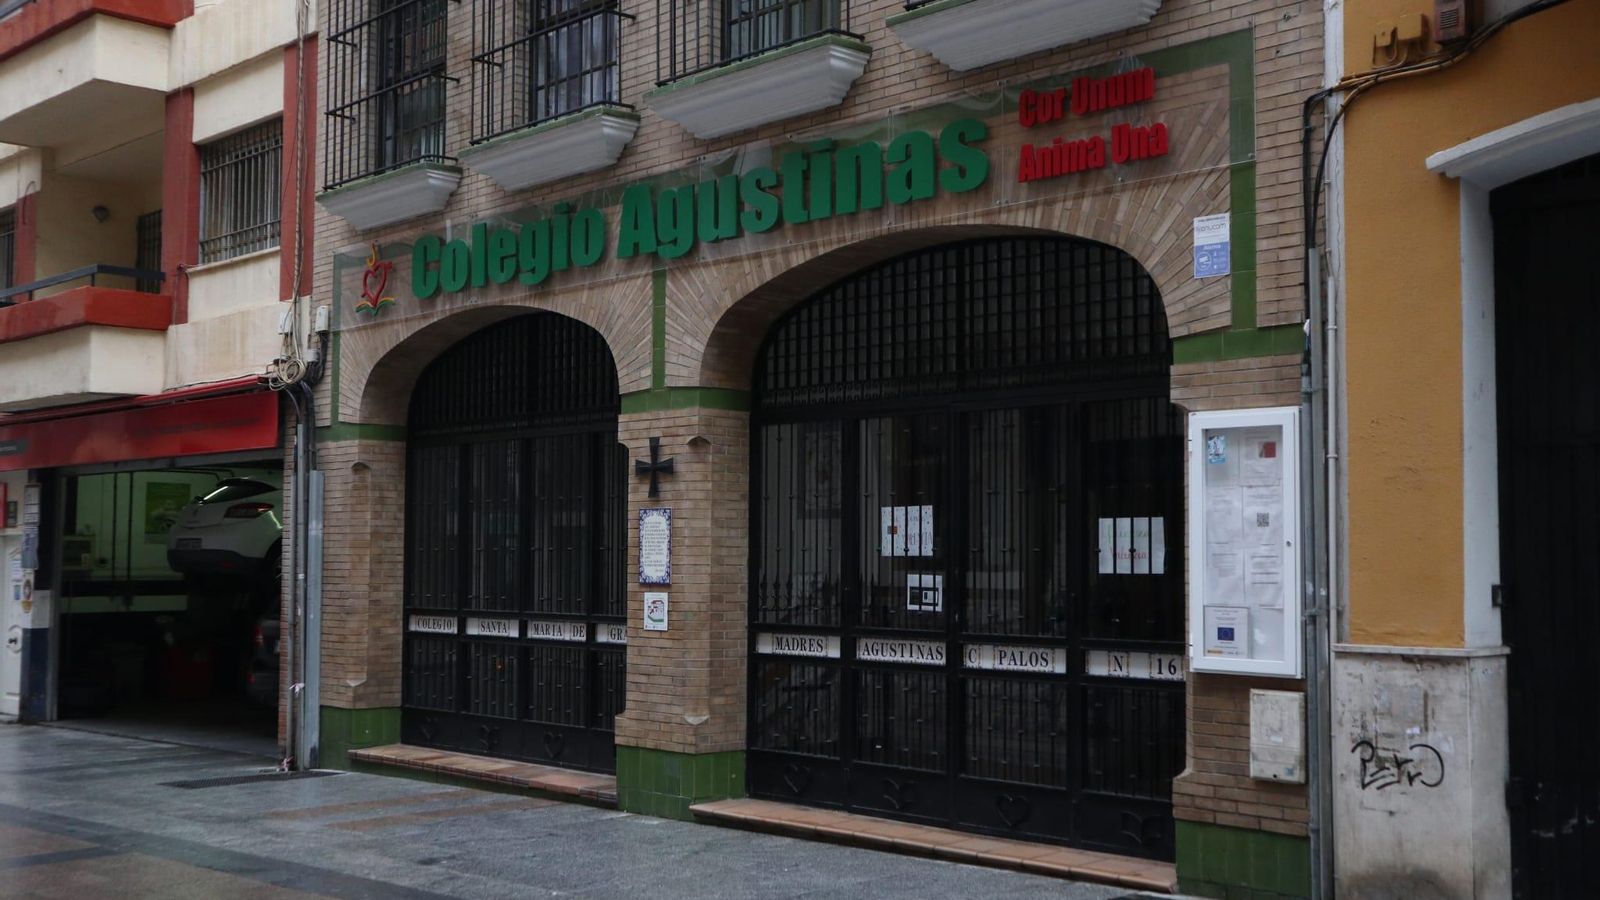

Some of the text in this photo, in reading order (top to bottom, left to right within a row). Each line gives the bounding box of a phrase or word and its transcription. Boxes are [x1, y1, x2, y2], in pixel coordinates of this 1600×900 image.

[1018, 67, 1156, 128] Cor Unum
[1018, 122, 1169, 183] Anima Una
[411, 117, 989, 299] Colegio Agustinas
[416, 616, 453, 631] COLEGIO
[480, 619, 508, 634] SANTA
[531, 622, 563, 638] MARIA
[571, 624, 586, 639] DE
[775, 636, 1177, 676] MADRES AGUSTINAS C PALOS N 16
